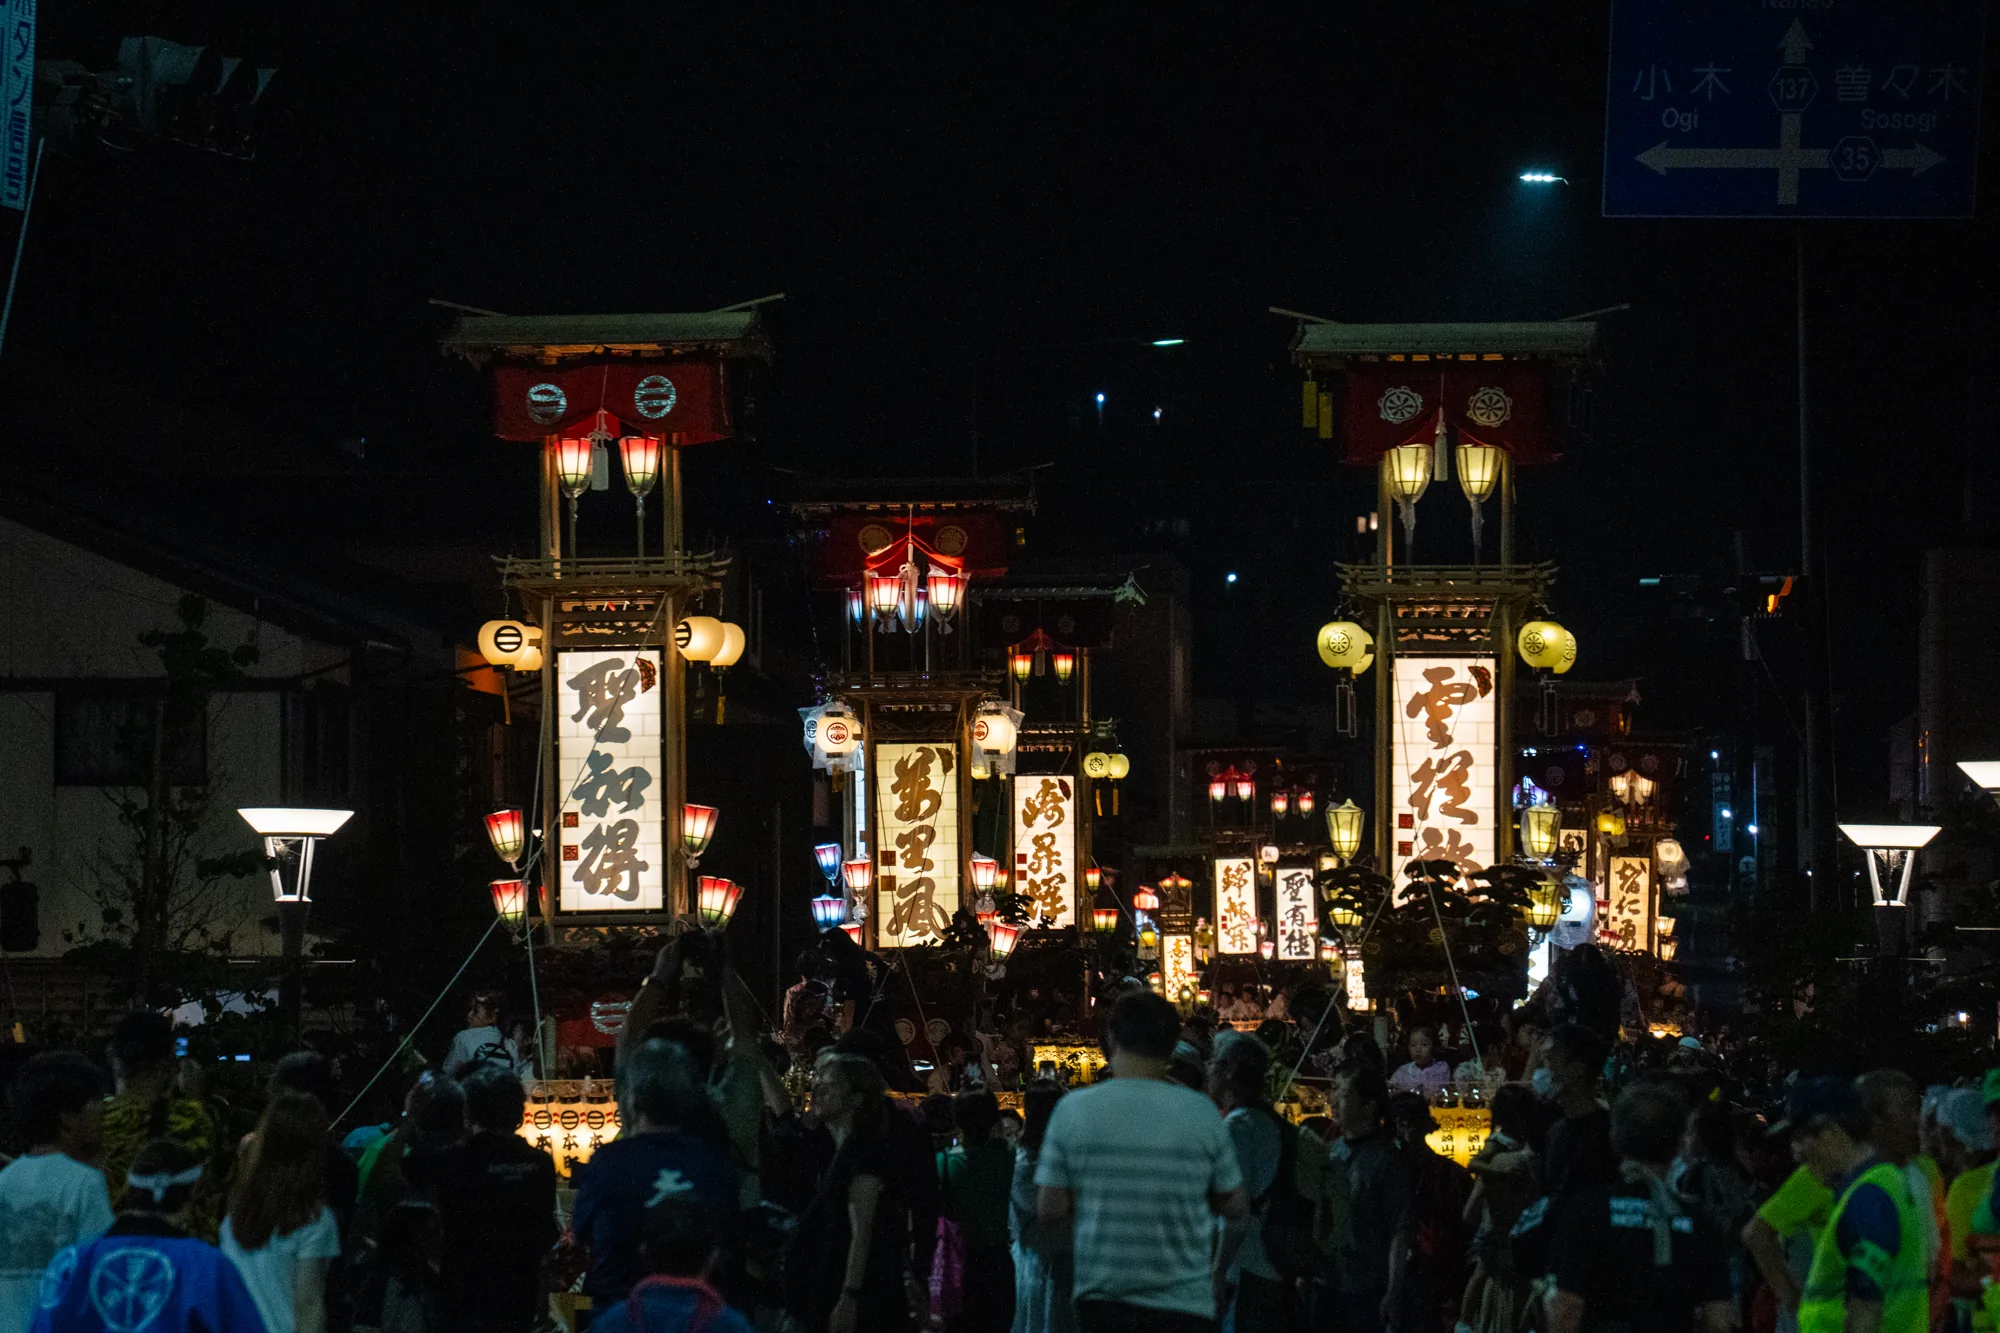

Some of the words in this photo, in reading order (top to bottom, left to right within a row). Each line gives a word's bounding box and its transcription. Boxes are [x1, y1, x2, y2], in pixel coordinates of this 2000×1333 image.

[1632, 62, 1731, 102] 小木
[1776, 78, 1809, 101] 137
[1835, 63, 1969, 102] 曽々木
[1661, 107, 1699, 131] Ogi
[1860, 108, 1937, 131] Sosogi
[1841, 147, 1869, 172] 35
